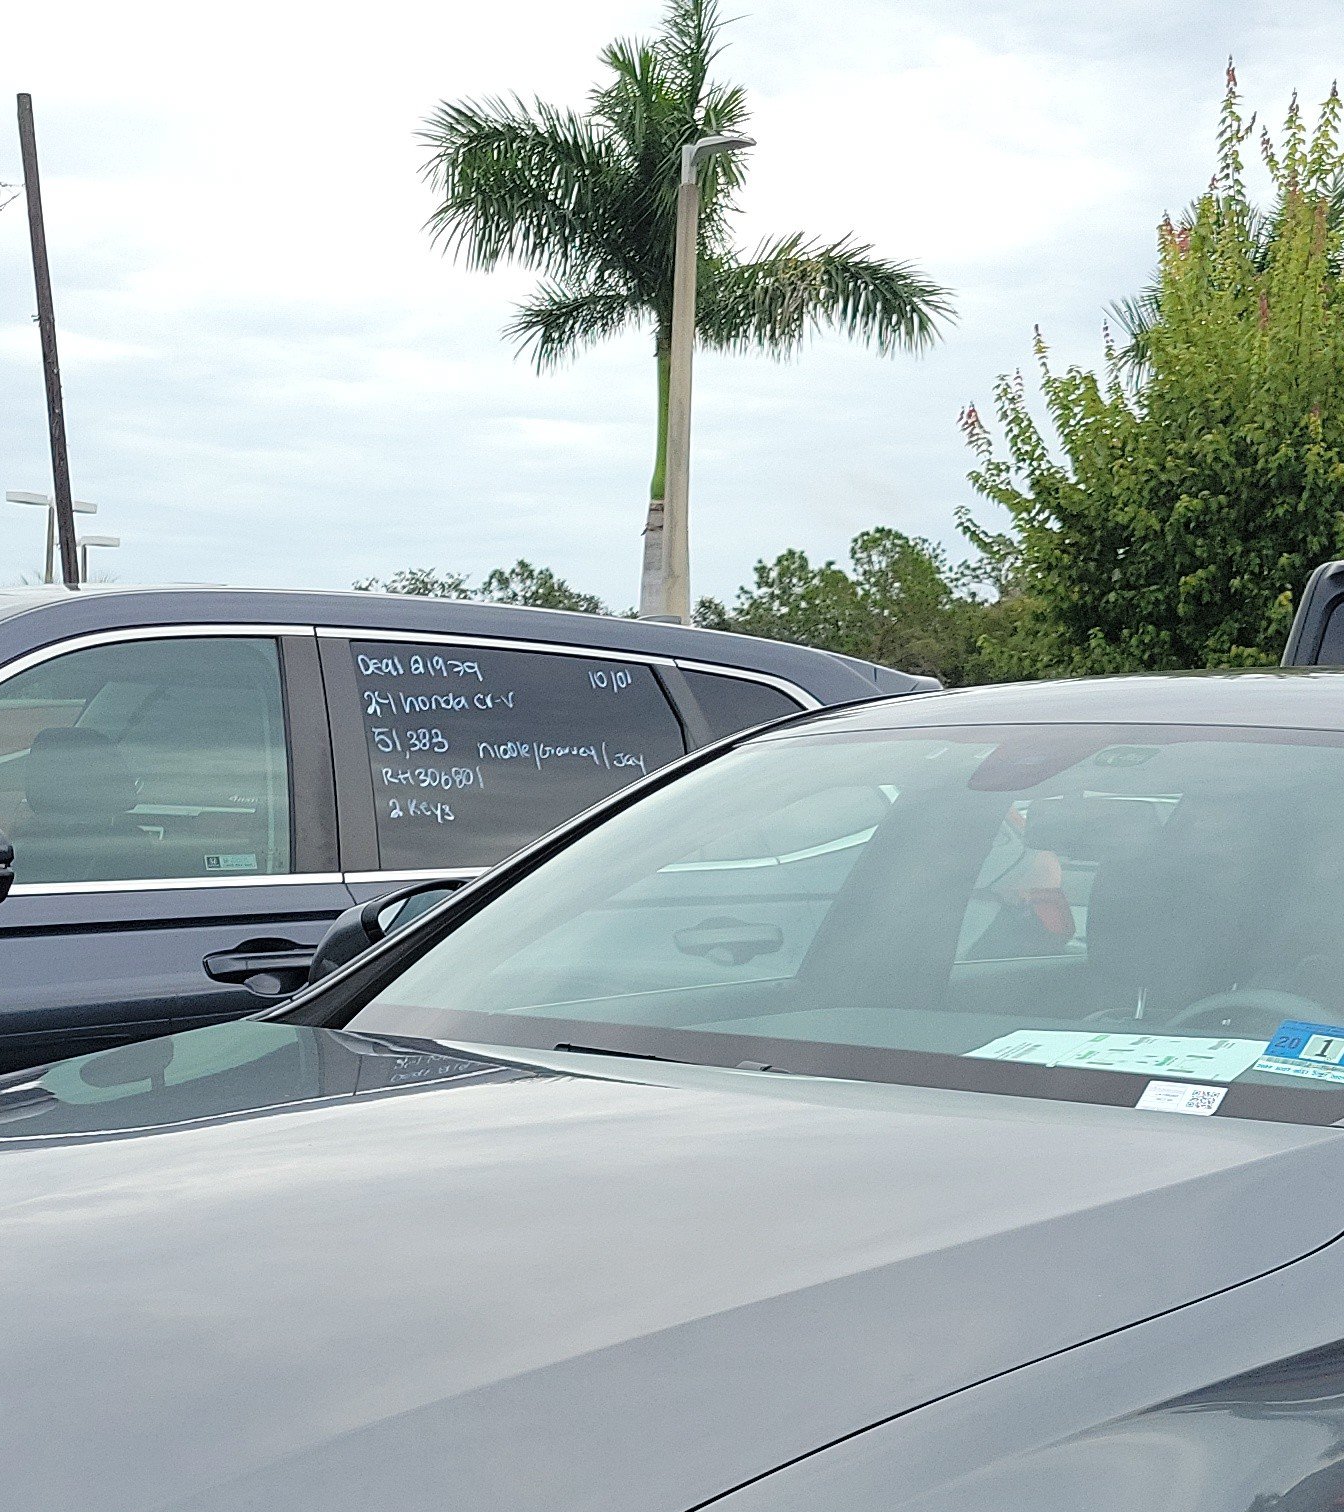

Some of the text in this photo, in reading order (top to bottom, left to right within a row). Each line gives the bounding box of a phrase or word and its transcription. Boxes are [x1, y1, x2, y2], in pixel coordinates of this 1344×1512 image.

[357, 654, 404, 677] Deal
[363, 691, 397, 718] 24
[389, 798, 404, 819] 2
[1275, 1036, 1301, 1050] 20
[1315, 1038, 1334, 1058] 1
